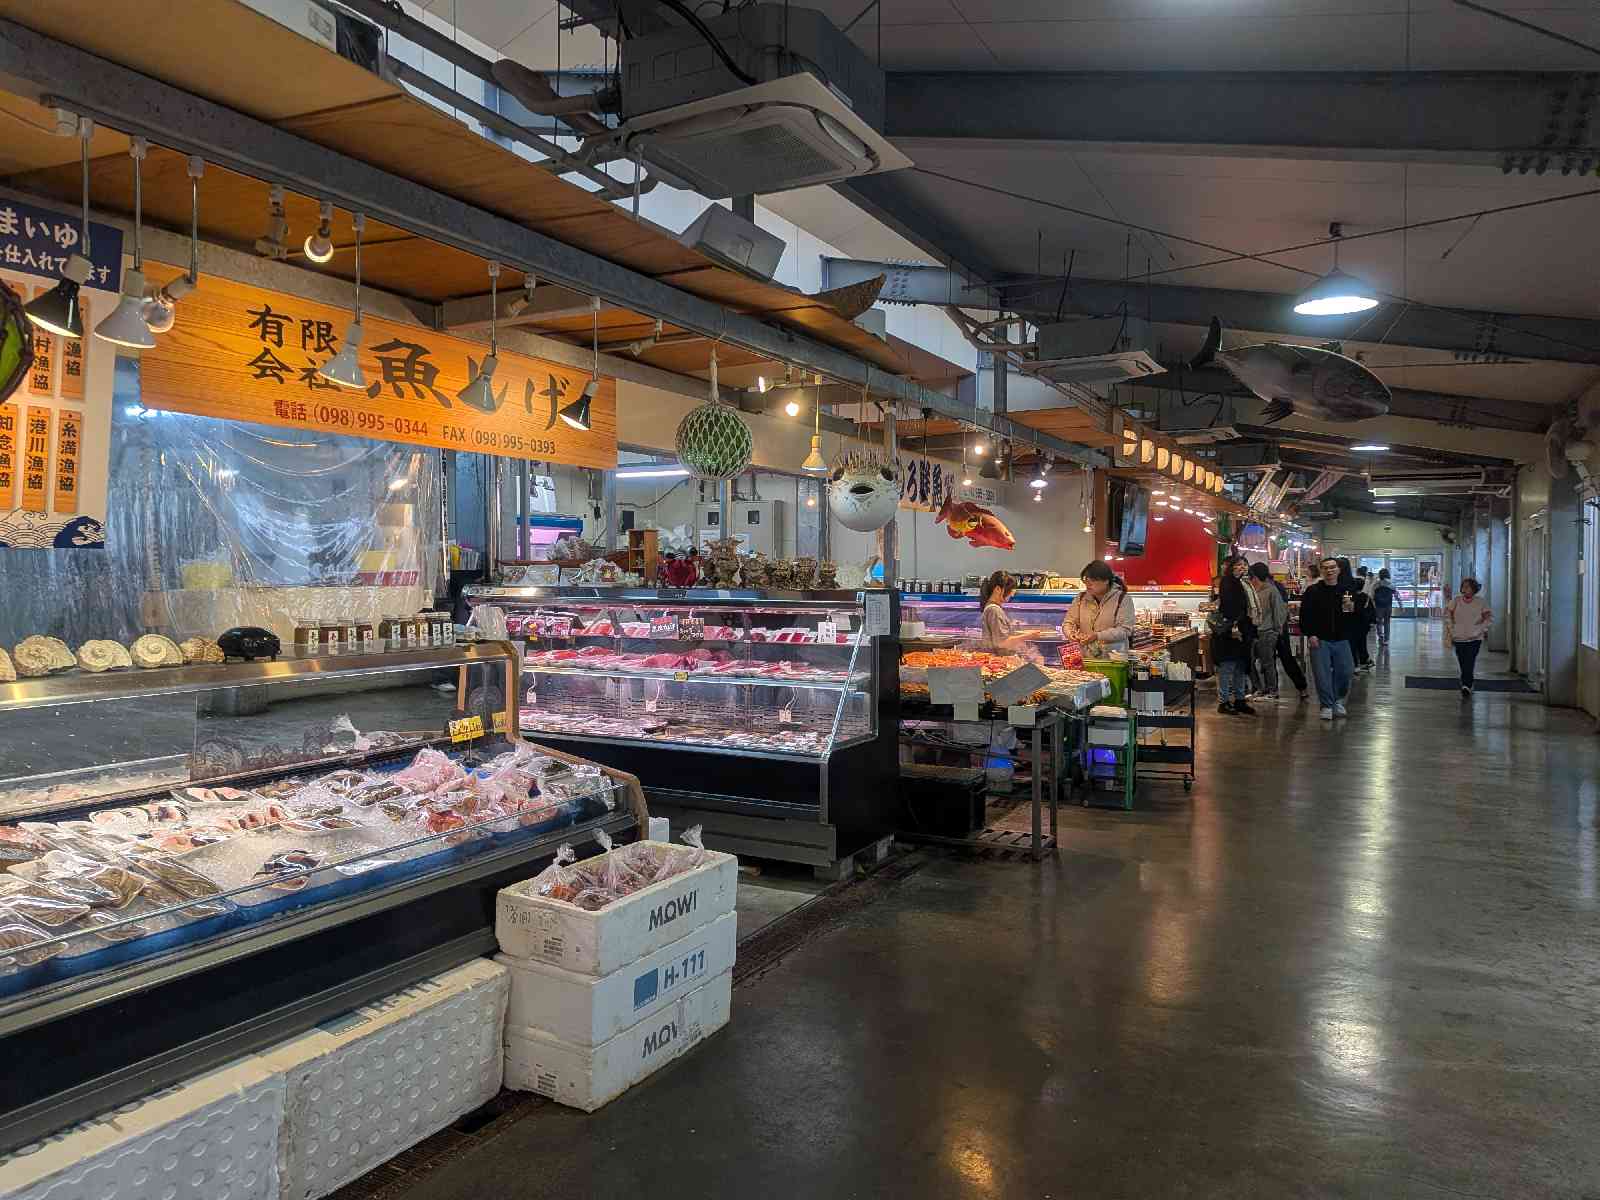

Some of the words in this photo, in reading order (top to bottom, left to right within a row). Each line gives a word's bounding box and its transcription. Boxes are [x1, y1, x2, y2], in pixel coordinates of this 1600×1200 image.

[246, 303, 339, 356] 有限
[273, 399, 307, 421] 電話
[442, 424, 467, 443] FAX
[27, 418, 48, 490] 港川漁協
